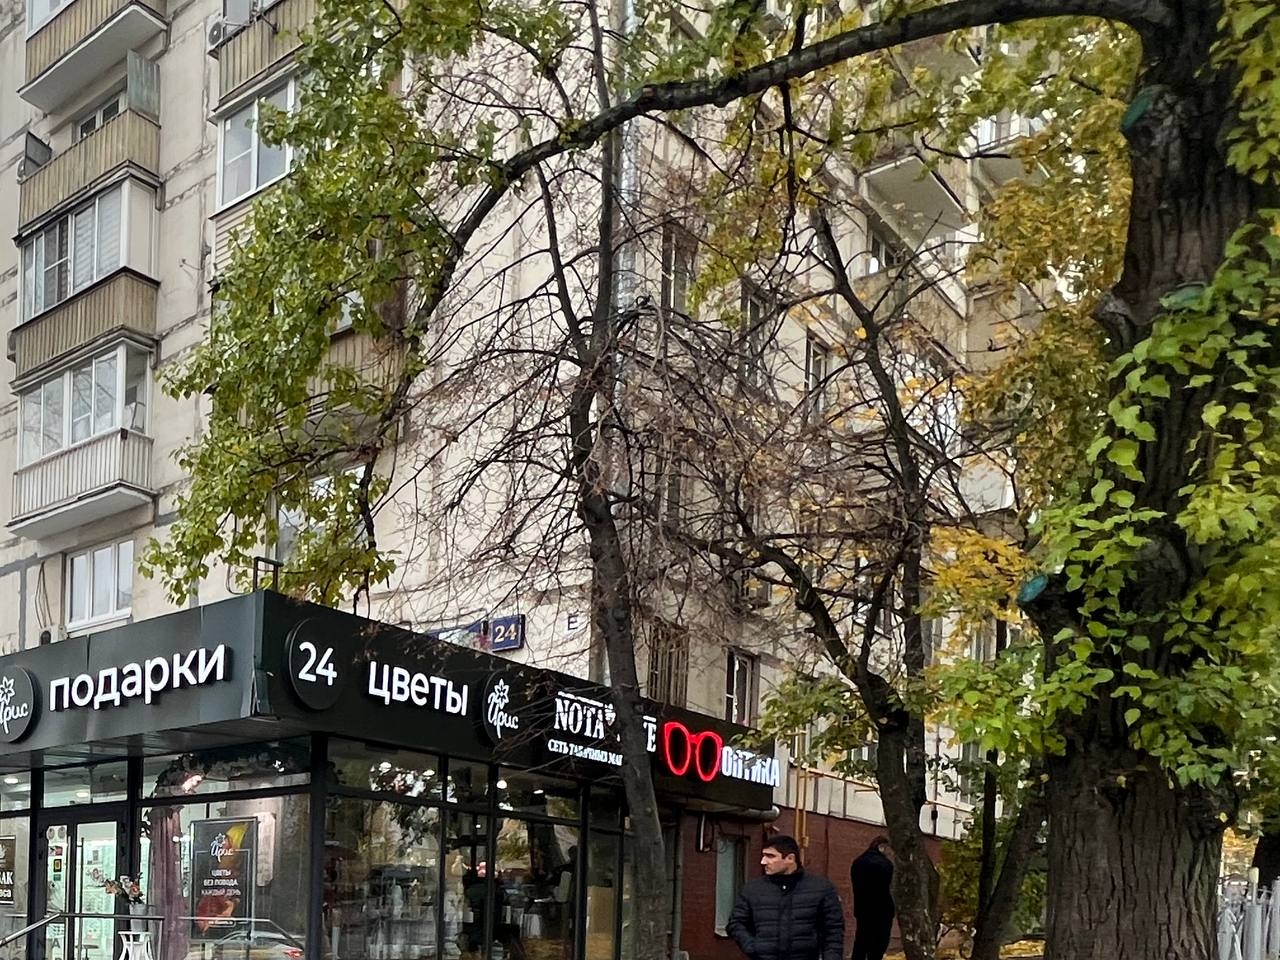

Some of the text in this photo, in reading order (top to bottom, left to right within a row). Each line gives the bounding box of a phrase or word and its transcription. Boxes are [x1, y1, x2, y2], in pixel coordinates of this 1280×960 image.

[494, 623, 517, 643] 24
[49, 644, 225, 712] подарки
[298, 641, 338, 686] 24
[369, 661, 469, 716] цветы
[554, 698, 605, 740] NOTA
[547, 738, 569, 755] СЕТЬ
[721, 745, 780, 788] ОПТИКА
